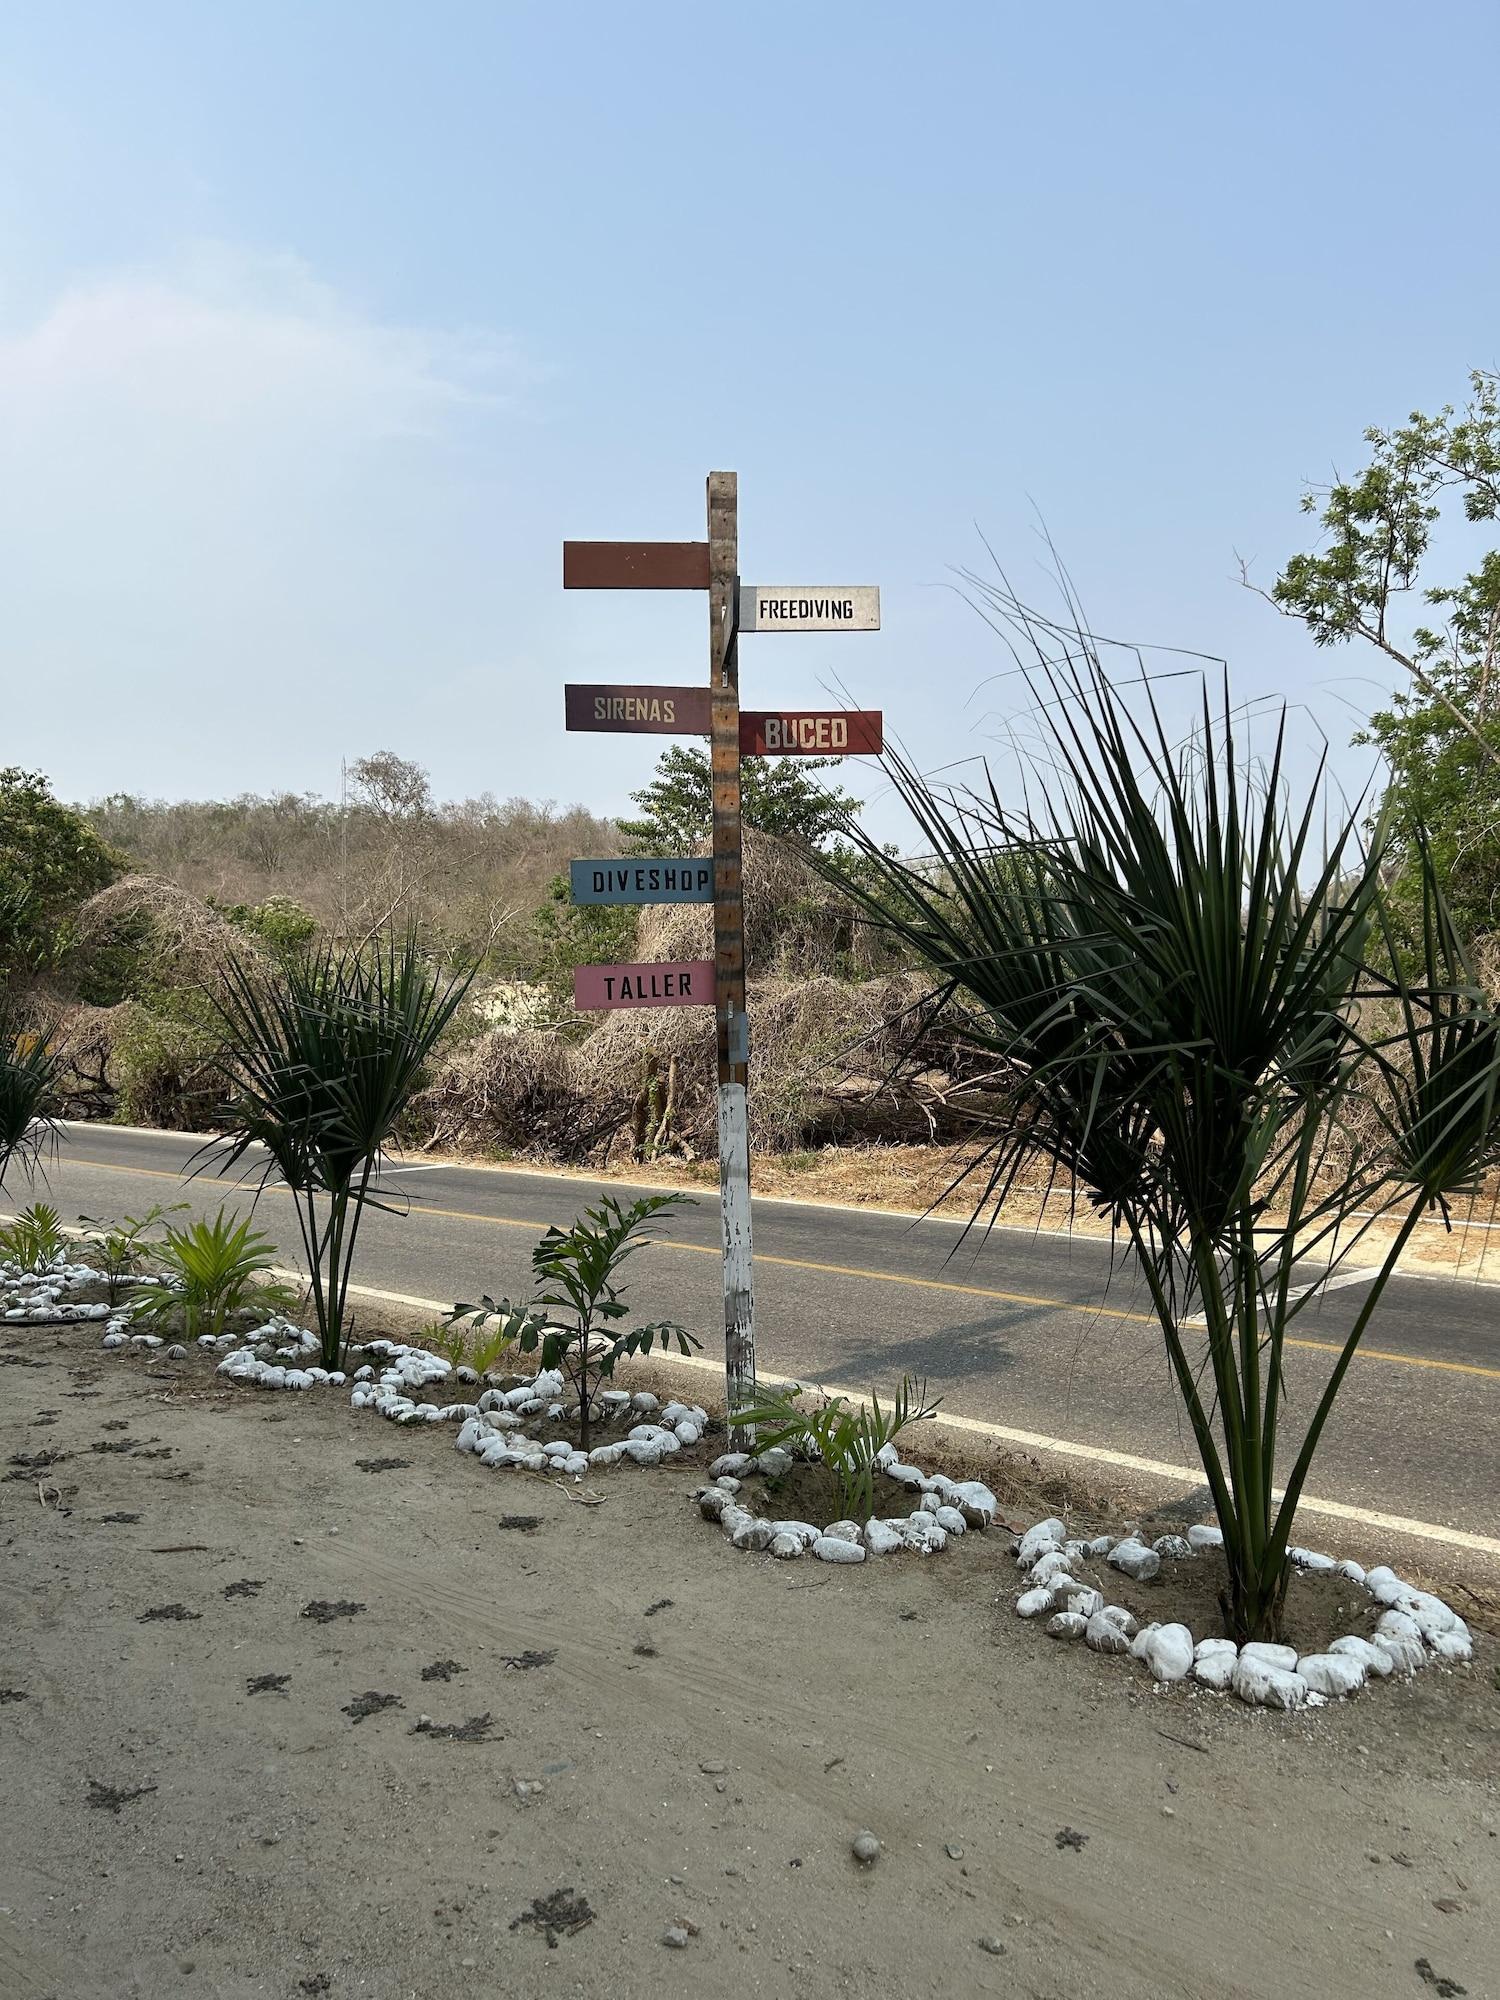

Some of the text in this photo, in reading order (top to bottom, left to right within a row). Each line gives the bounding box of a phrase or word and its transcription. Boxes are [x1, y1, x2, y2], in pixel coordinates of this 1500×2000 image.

[760, 600, 853, 619] FREEDIVING
[594, 697, 675, 722] SIRENAS
[593, 869, 709, 893] DIVESHOP
[604, 974, 692, 1000] TALLER
